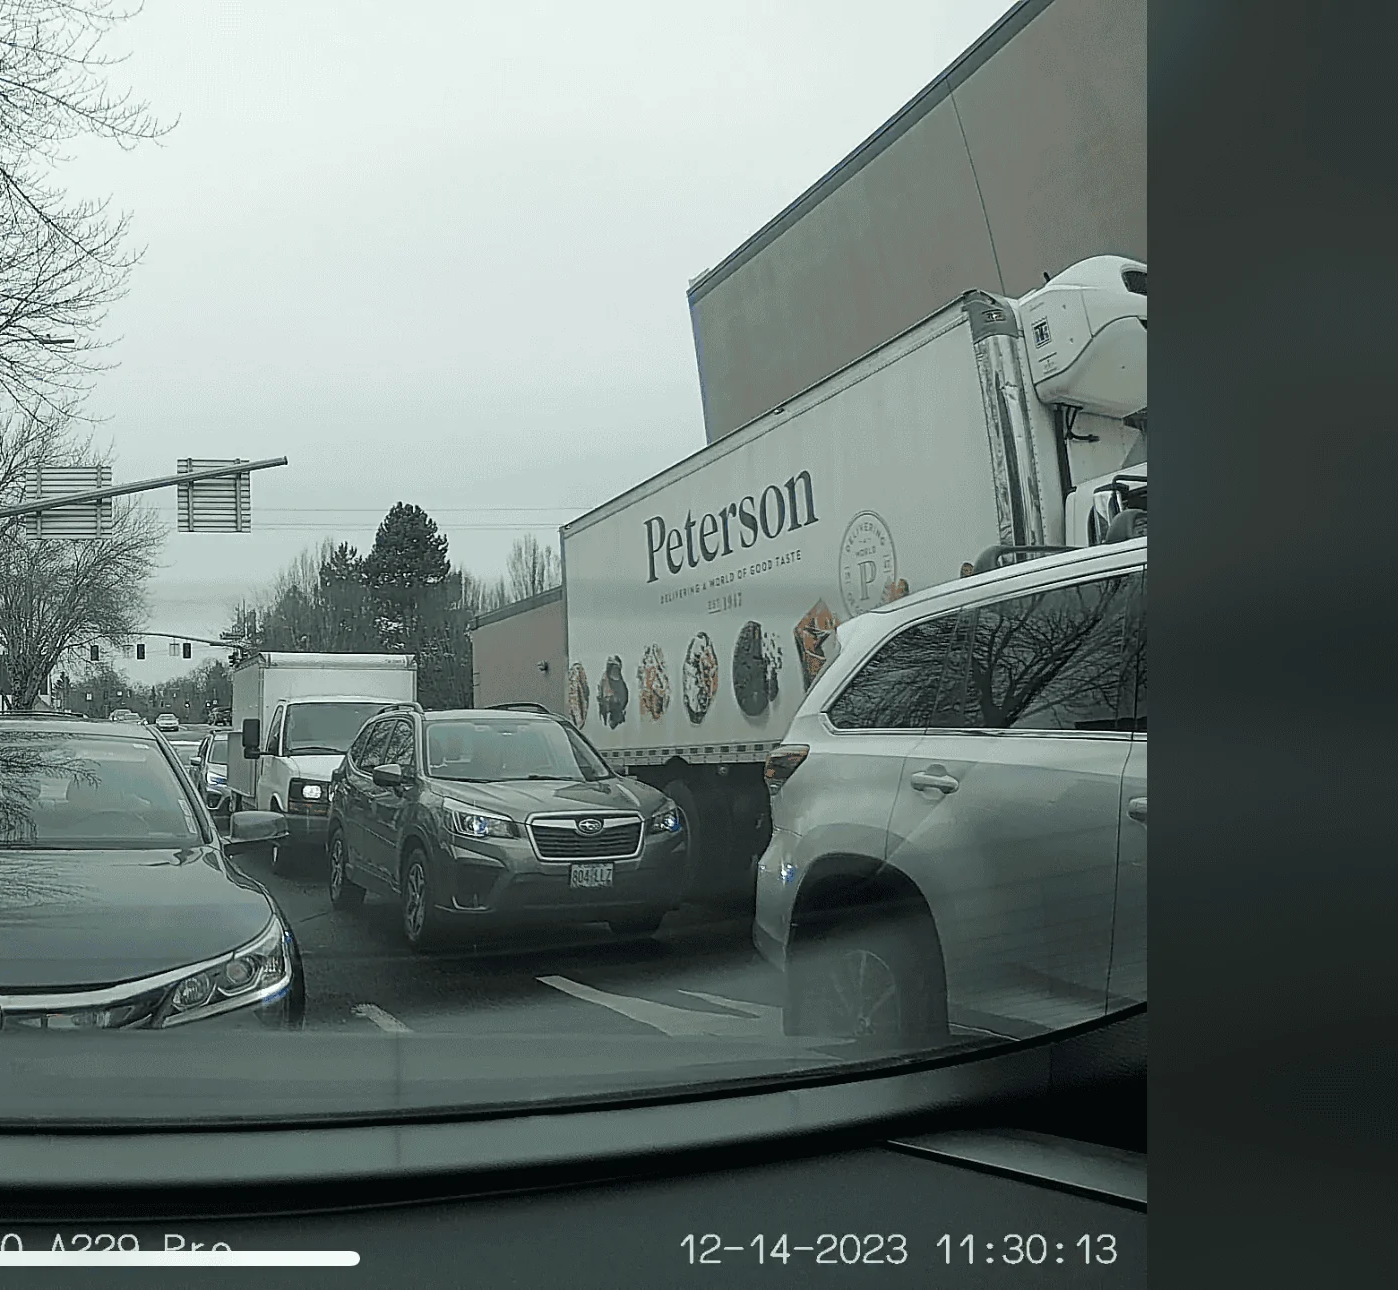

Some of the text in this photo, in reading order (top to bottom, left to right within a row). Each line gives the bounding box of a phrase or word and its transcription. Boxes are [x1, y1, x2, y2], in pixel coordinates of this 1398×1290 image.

[644, 470, 819, 584] Peterson
[660, 584, 700, 605] DELIVERING
[709, 572, 735, 588] WORLD
[737, 567, 747, 580] OF
[750, 559, 773, 575] GOOD
[775, 549, 802, 567] TASTE
[857, 560, 877, 601] P
